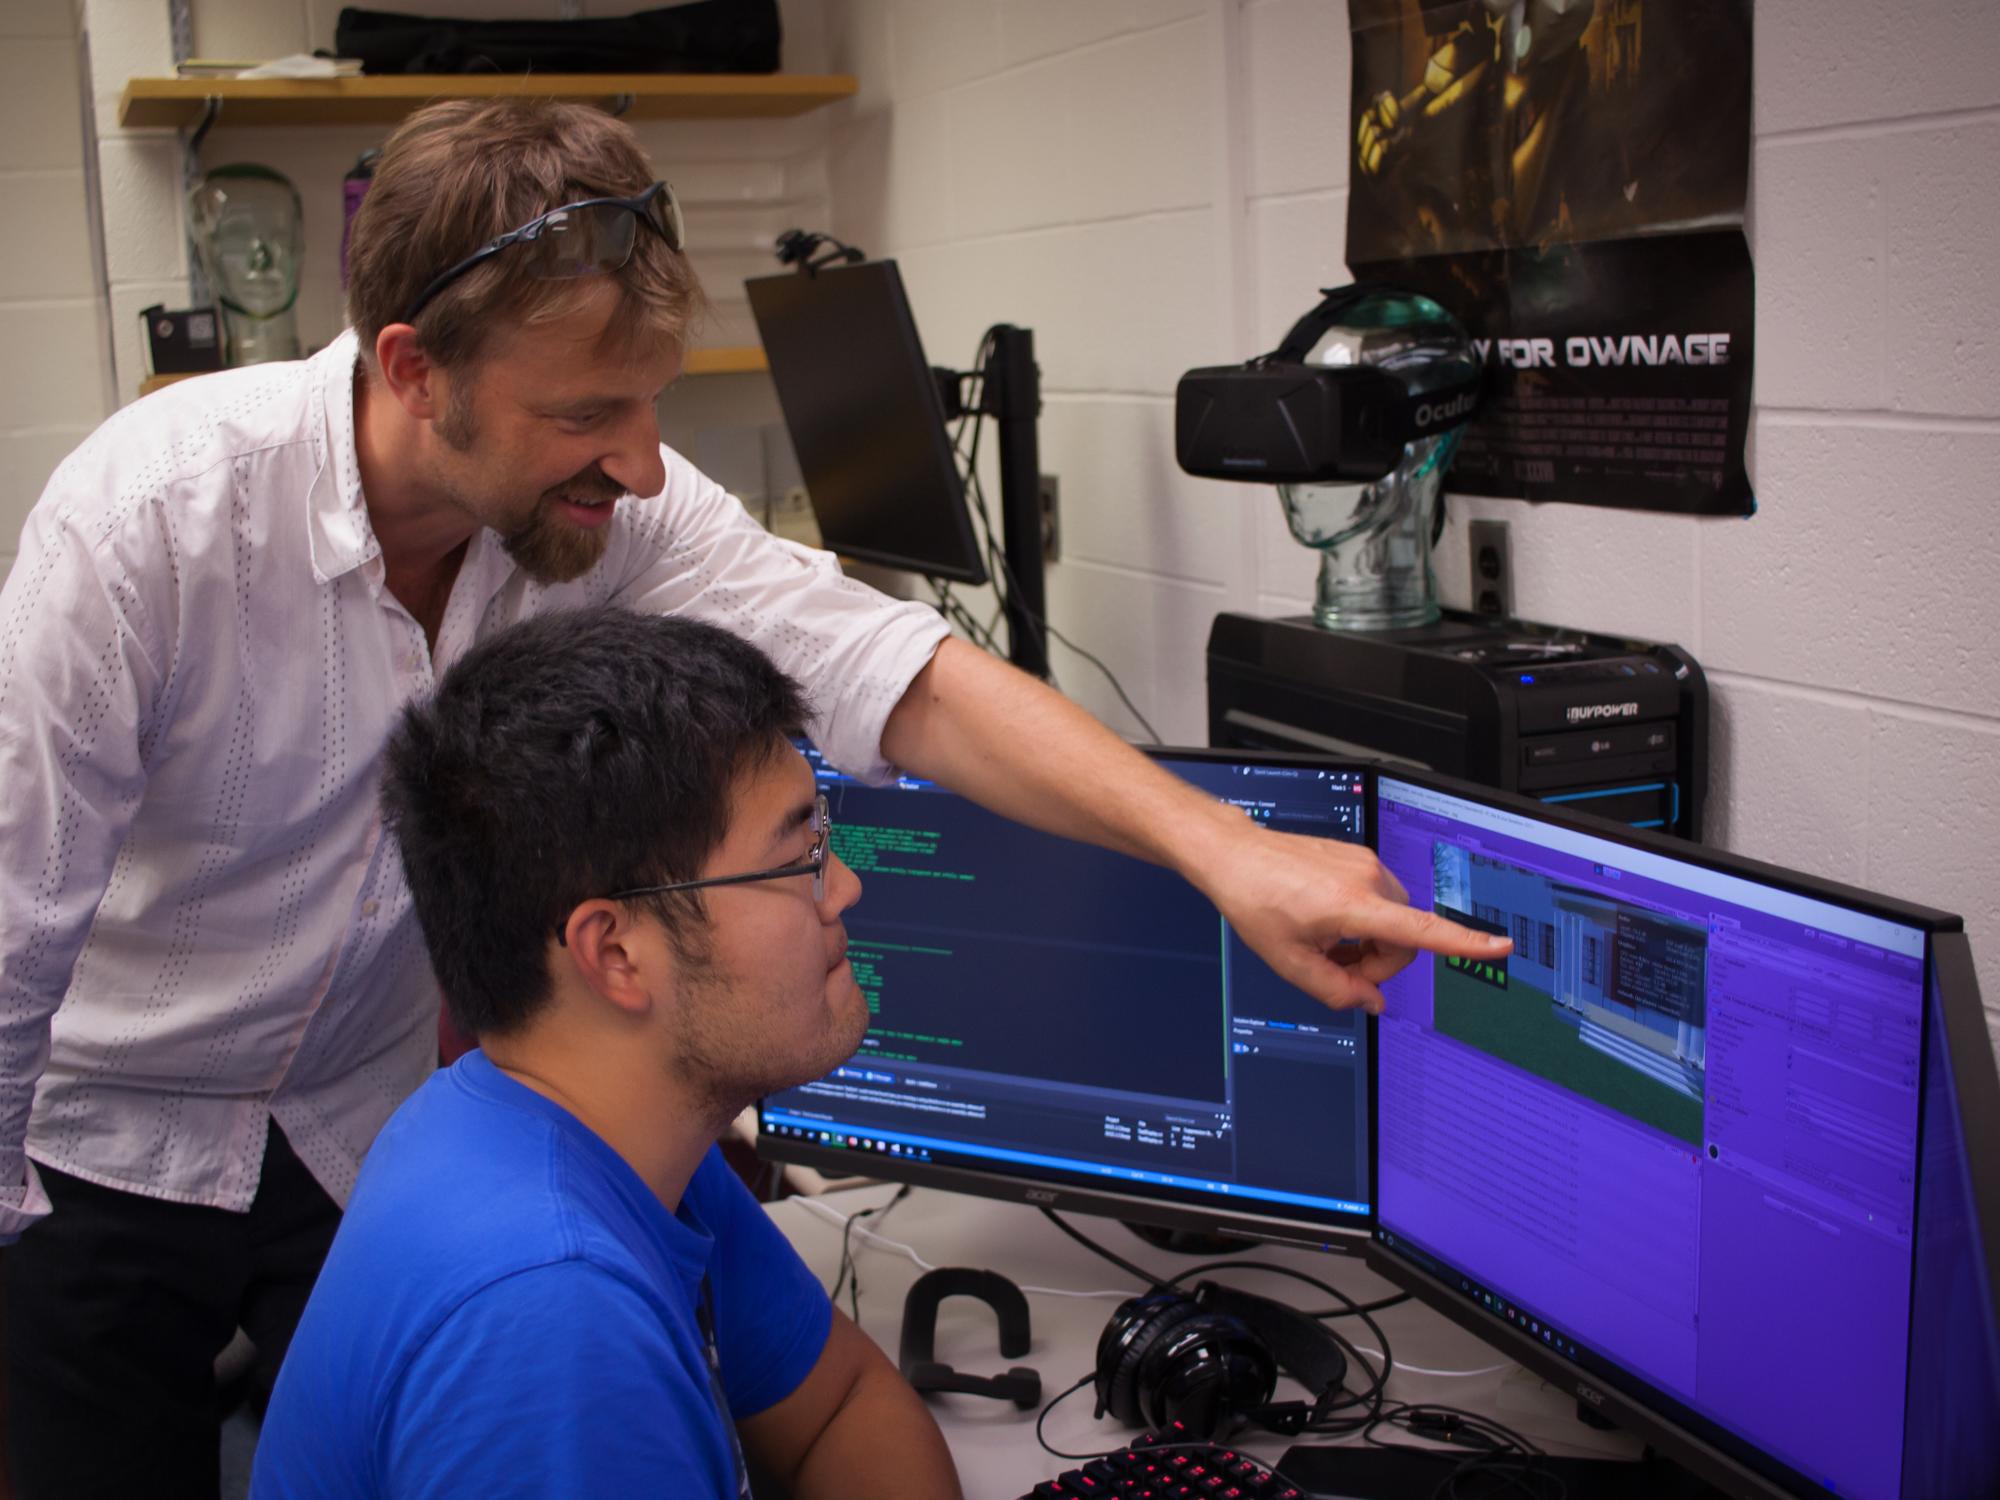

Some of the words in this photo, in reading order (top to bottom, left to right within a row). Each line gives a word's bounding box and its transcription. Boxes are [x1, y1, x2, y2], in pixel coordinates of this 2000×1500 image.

[1498, 338, 1555, 368] FOR
[1566, 333, 1730, 366] OWNAGE
[1415, 392, 1479, 427] Oculu
[1025, 1188, 1059, 1202] acer
